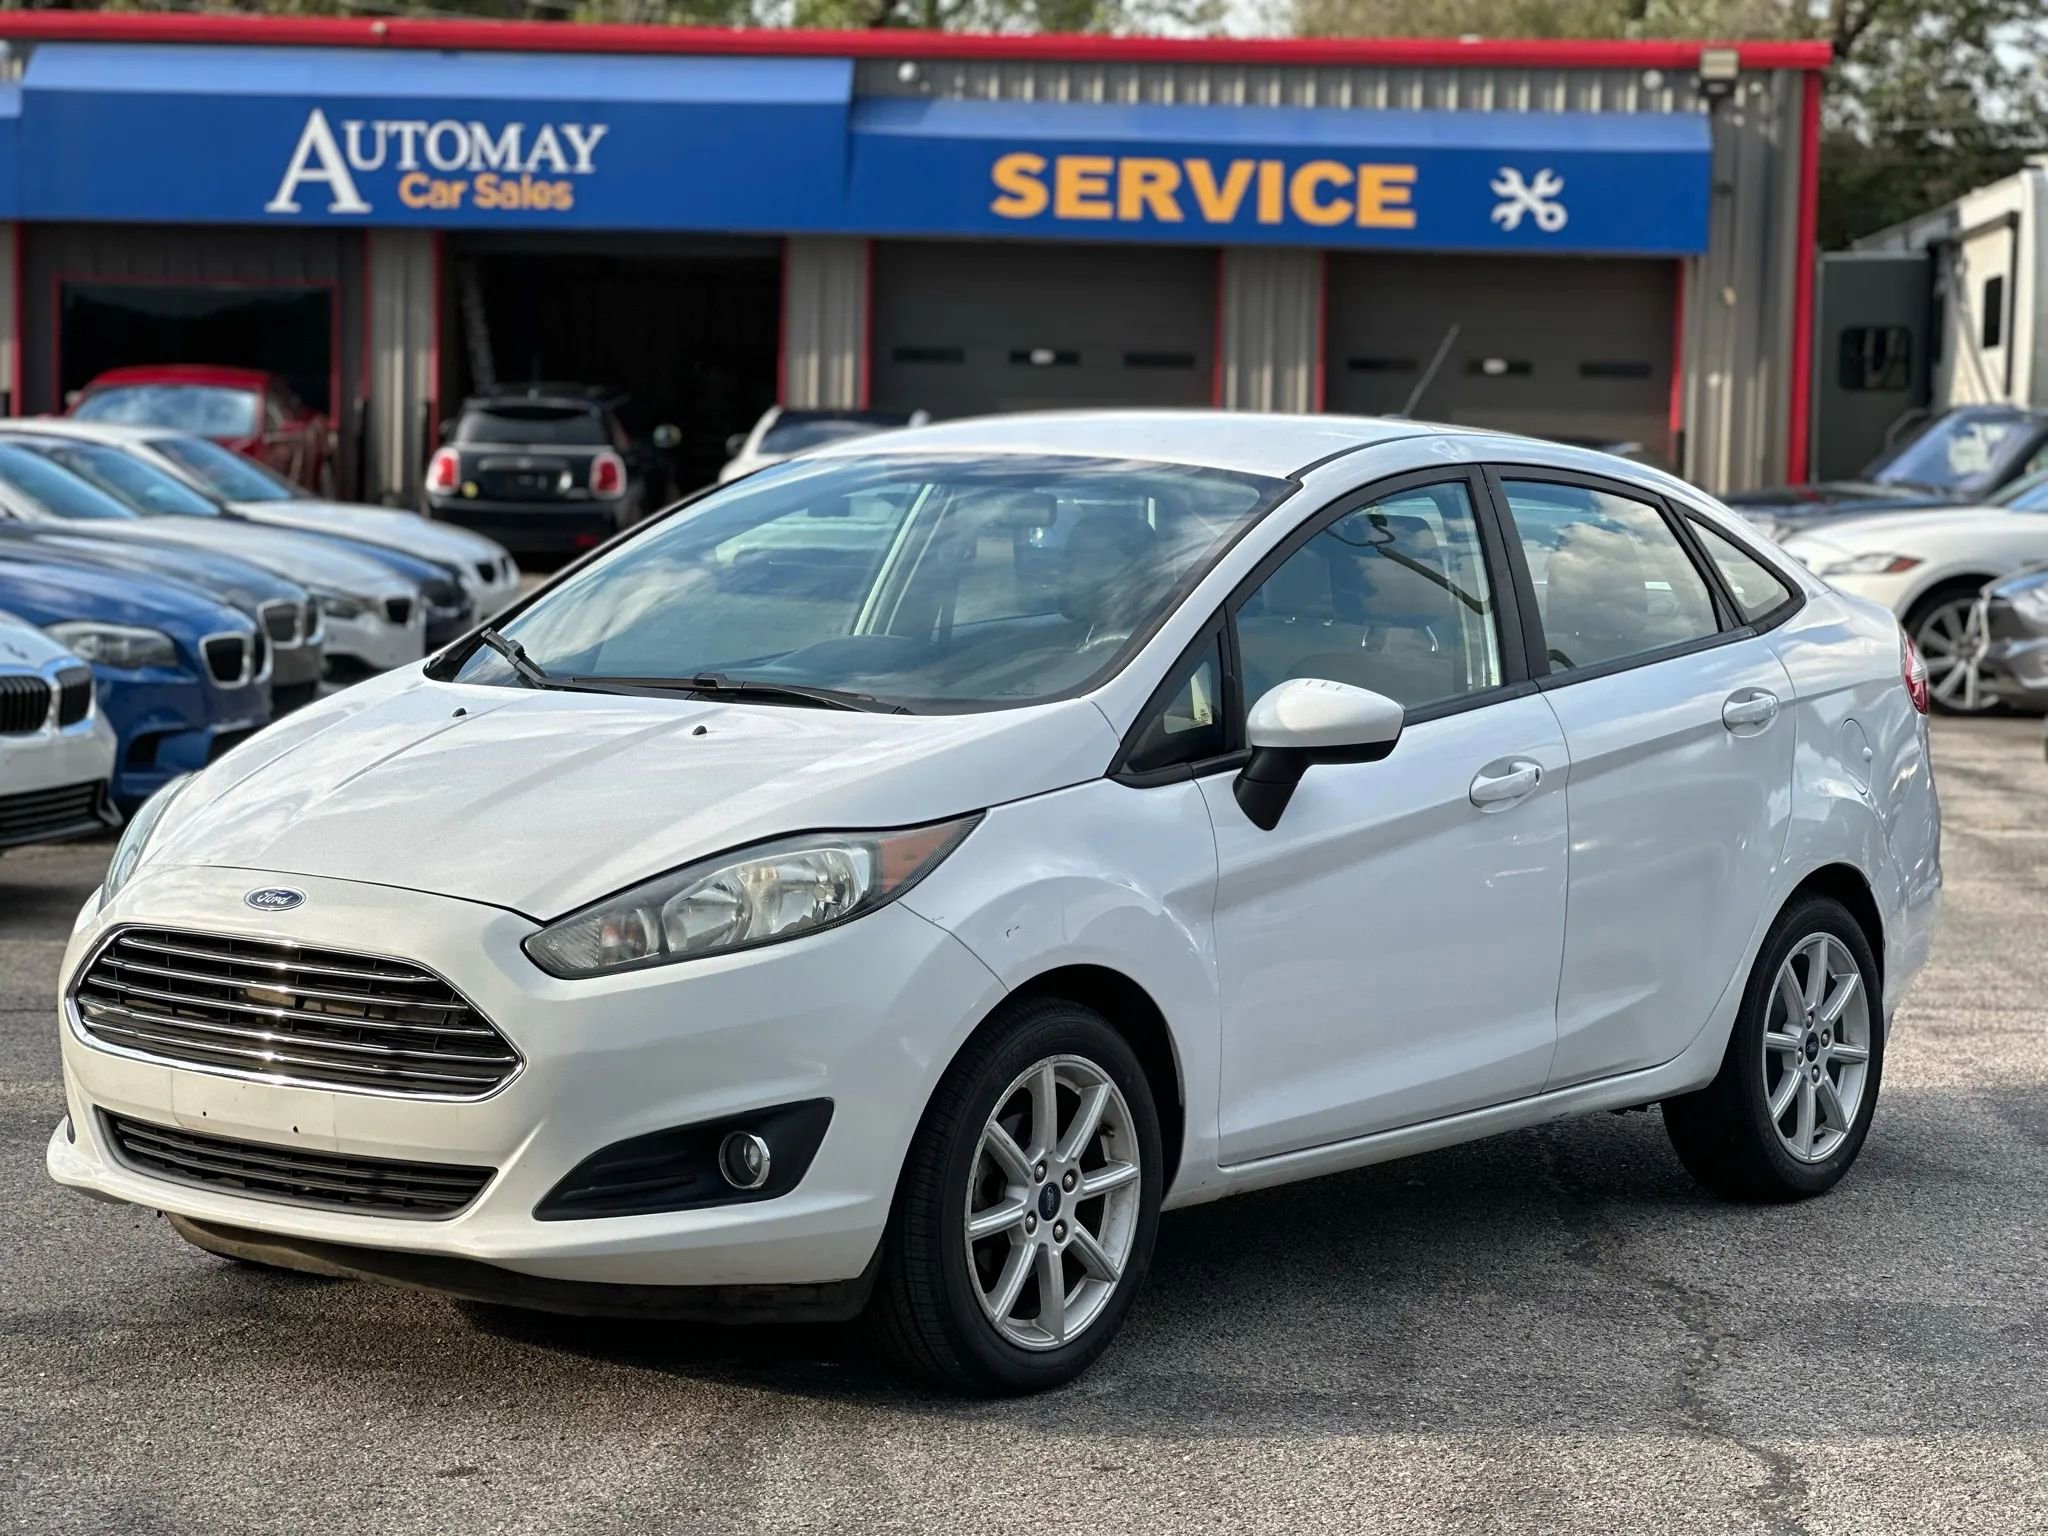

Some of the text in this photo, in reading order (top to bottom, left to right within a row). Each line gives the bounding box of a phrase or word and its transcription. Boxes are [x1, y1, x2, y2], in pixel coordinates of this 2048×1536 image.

[265, 107, 608, 213] AUTOMAY
[399, 172, 573, 210] Car Sales
[991, 153, 1417, 229] SERVICE
